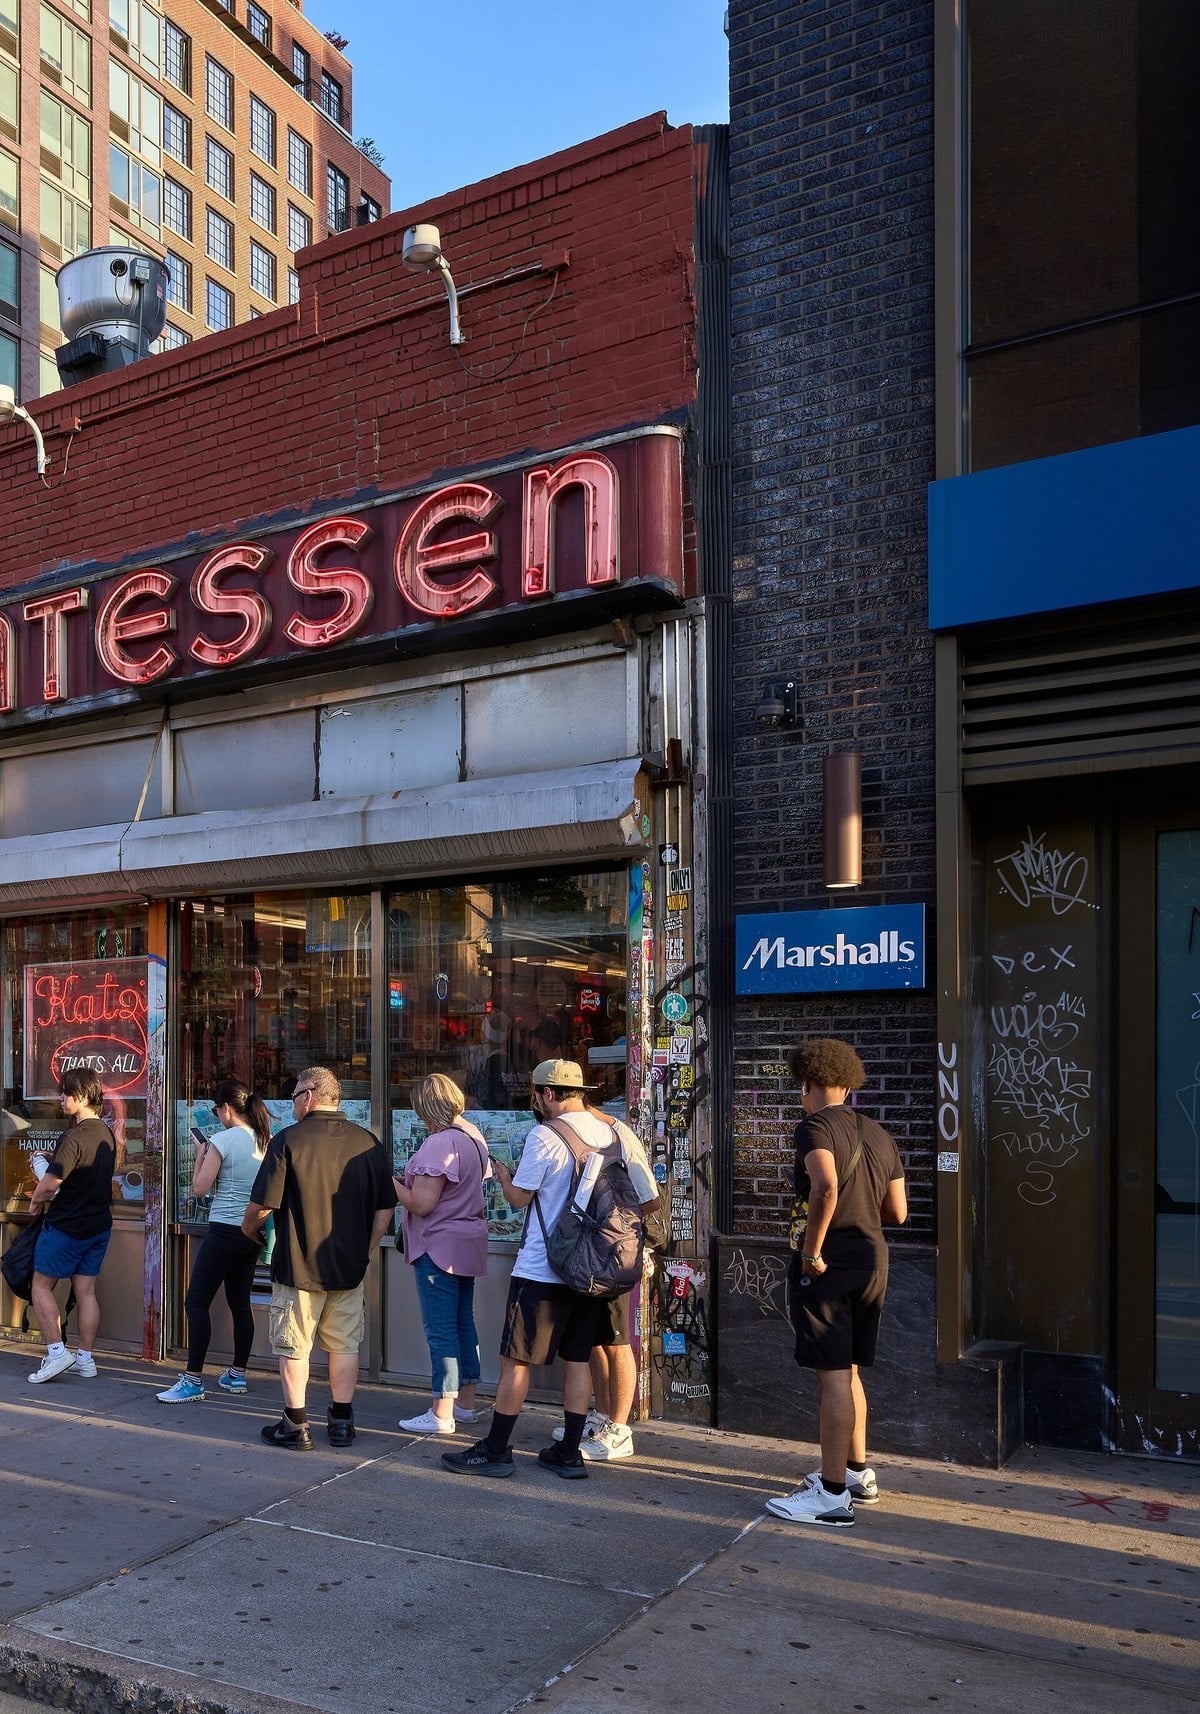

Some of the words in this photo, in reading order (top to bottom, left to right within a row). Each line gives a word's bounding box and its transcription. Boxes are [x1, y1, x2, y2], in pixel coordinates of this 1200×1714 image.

[742, 930, 916, 969] Marshalls
[111, 1054, 137, 1073] ALL
[938, 1042, 960, 1141] UNO
[467, 1456, 489, 1465] HOKA
